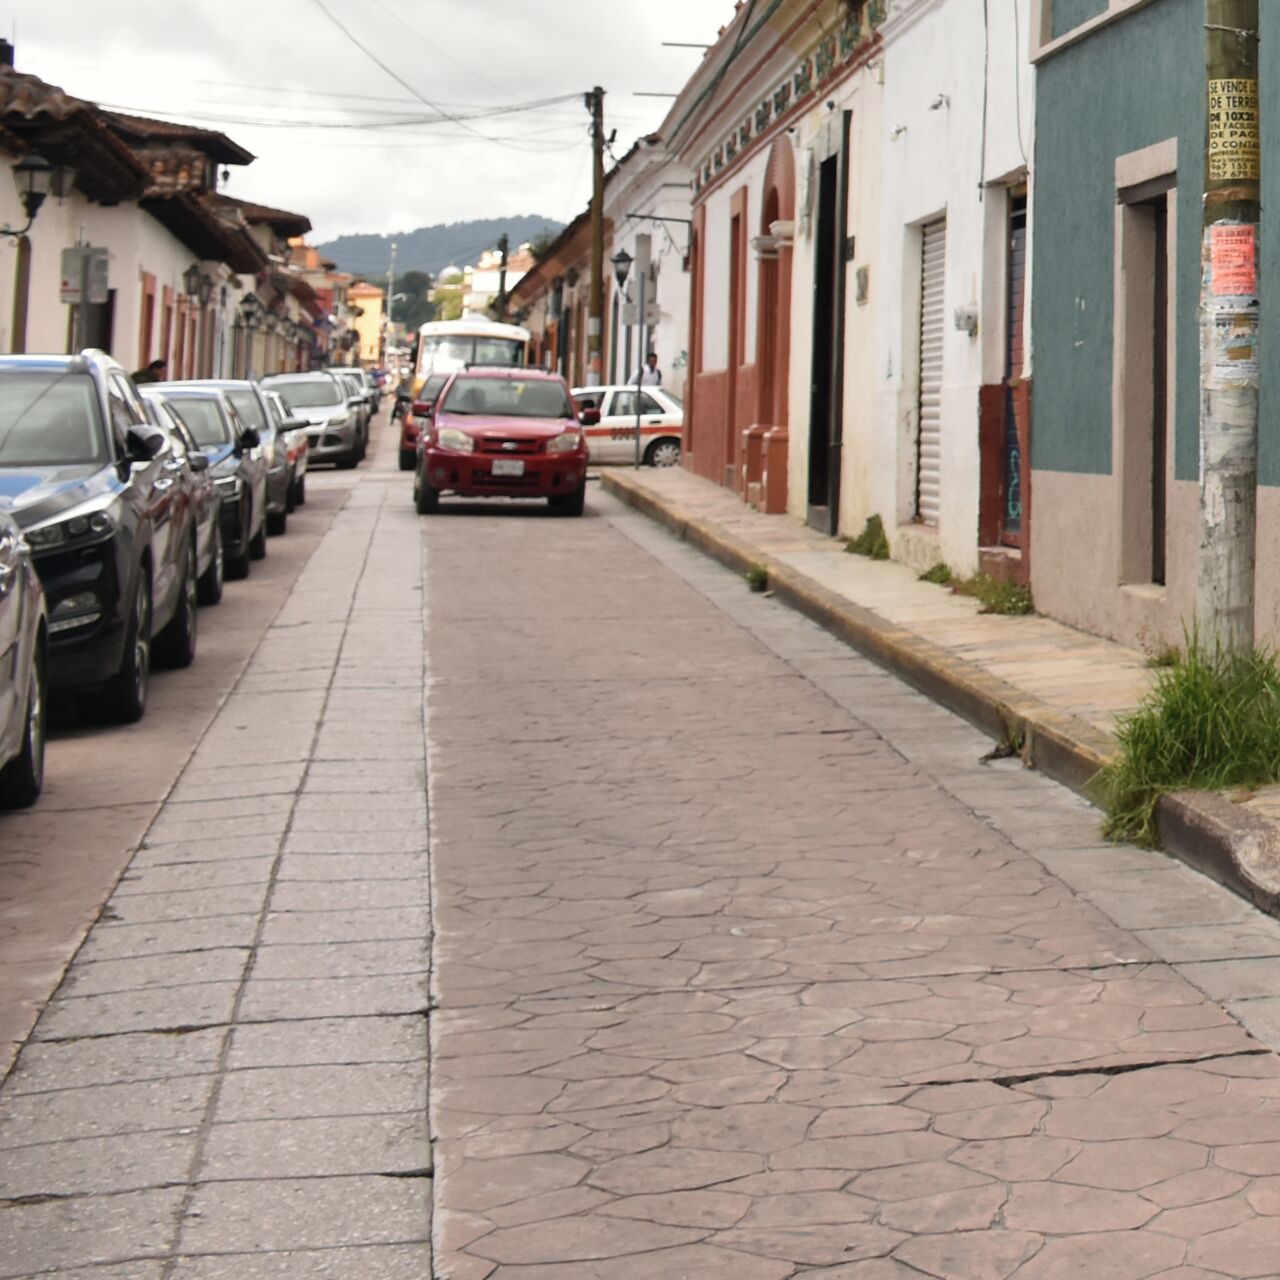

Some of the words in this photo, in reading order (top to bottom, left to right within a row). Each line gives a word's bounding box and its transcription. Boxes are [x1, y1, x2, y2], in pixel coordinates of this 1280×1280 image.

[1210, 81, 1218, 94] SE
[1220, 81, 1248, 93] VENDE
[1210, 96, 1222, 109] DE
[1210, 112, 1221, 121] DE
[1210, 130, 1225, 139] DE
